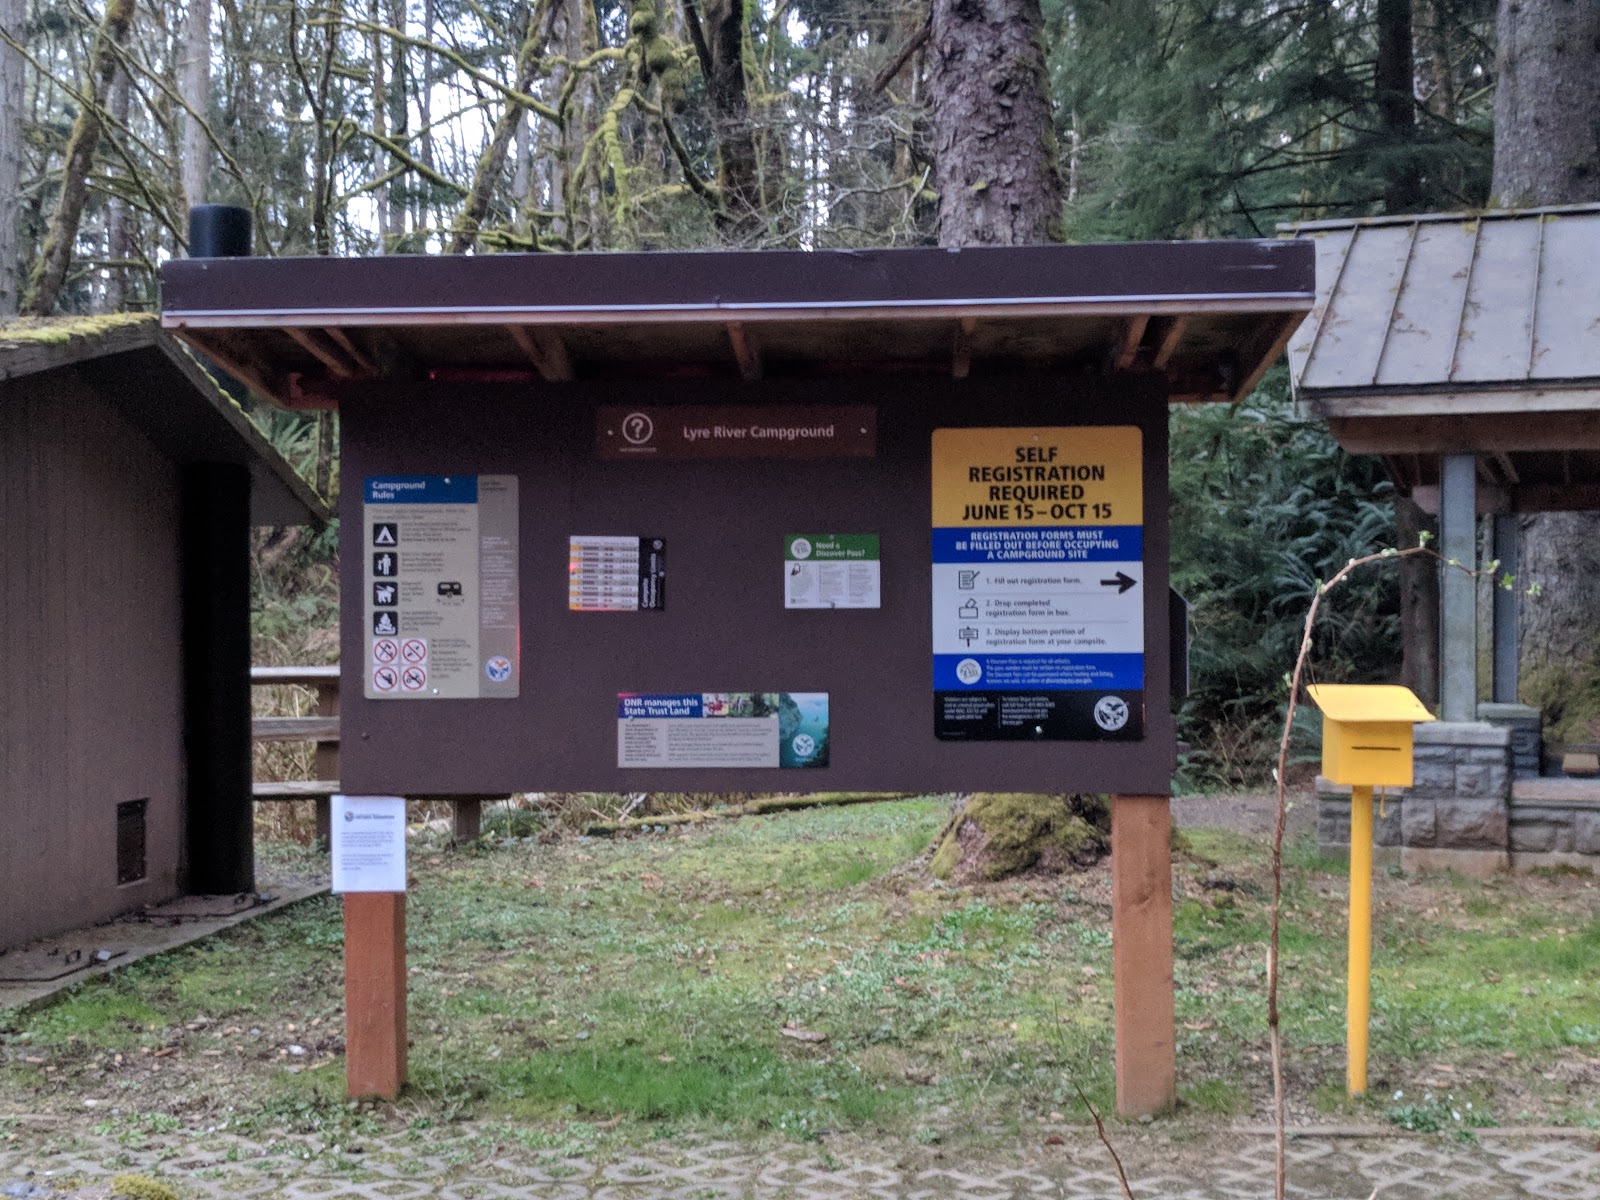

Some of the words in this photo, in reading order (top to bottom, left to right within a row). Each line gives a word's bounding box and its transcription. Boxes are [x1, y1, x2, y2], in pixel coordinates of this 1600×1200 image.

[684, 426, 710, 441] Lyre
[714, 426, 747, 438] River
[750, 425, 834, 441] Campground
[1016, 447, 1058, 462] SELF
[968, 466, 1105, 482] REGISTRATION
[372, 481, 426, 492] Campground
[372, 491, 395, 499] Rules
[990, 485, 1084, 503] REQUIRED
[962, 504, 1008, 520] JUNE
[1092, 503, 1112, 518] 15
[970, 531, 1038, 541] REGISTRATION
[1041, 530, 1074, 540] FORMS
[1076, 530, 1104, 540] MUST
[956, 542, 968, 550] BE
[970, 541, 1001, 550] FILLED
[1004, 540, 1022, 550] OUT
[1026, 540, 1061, 550] BEFORE
[1064, 539, 1120, 550] OCCUPYING
[987, 550, 994, 560] A
[996, 550, 1065, 560] CAMPGROUND
[1068, 550, 1088, 558] SITE
[1020, 577, 1062, 585] registration
[994, 600, 1012, 608] Drop
[1013, 599, 1050, 608] completed
[986, 610, 1026, 618] registration
[995, 628, 1020, 636] Display
[1050, 628, 1076, 636] portion
[986, 638, 1026, 646] registration
[624, 698, 642, 706] DNR
[644, 699, 681, 708] manages
[683, 698, 698, 706] this
[624, 707, 646, 715] State
[648, 707, 668, 715] Trust
[670, 707, 690, 715] Land
